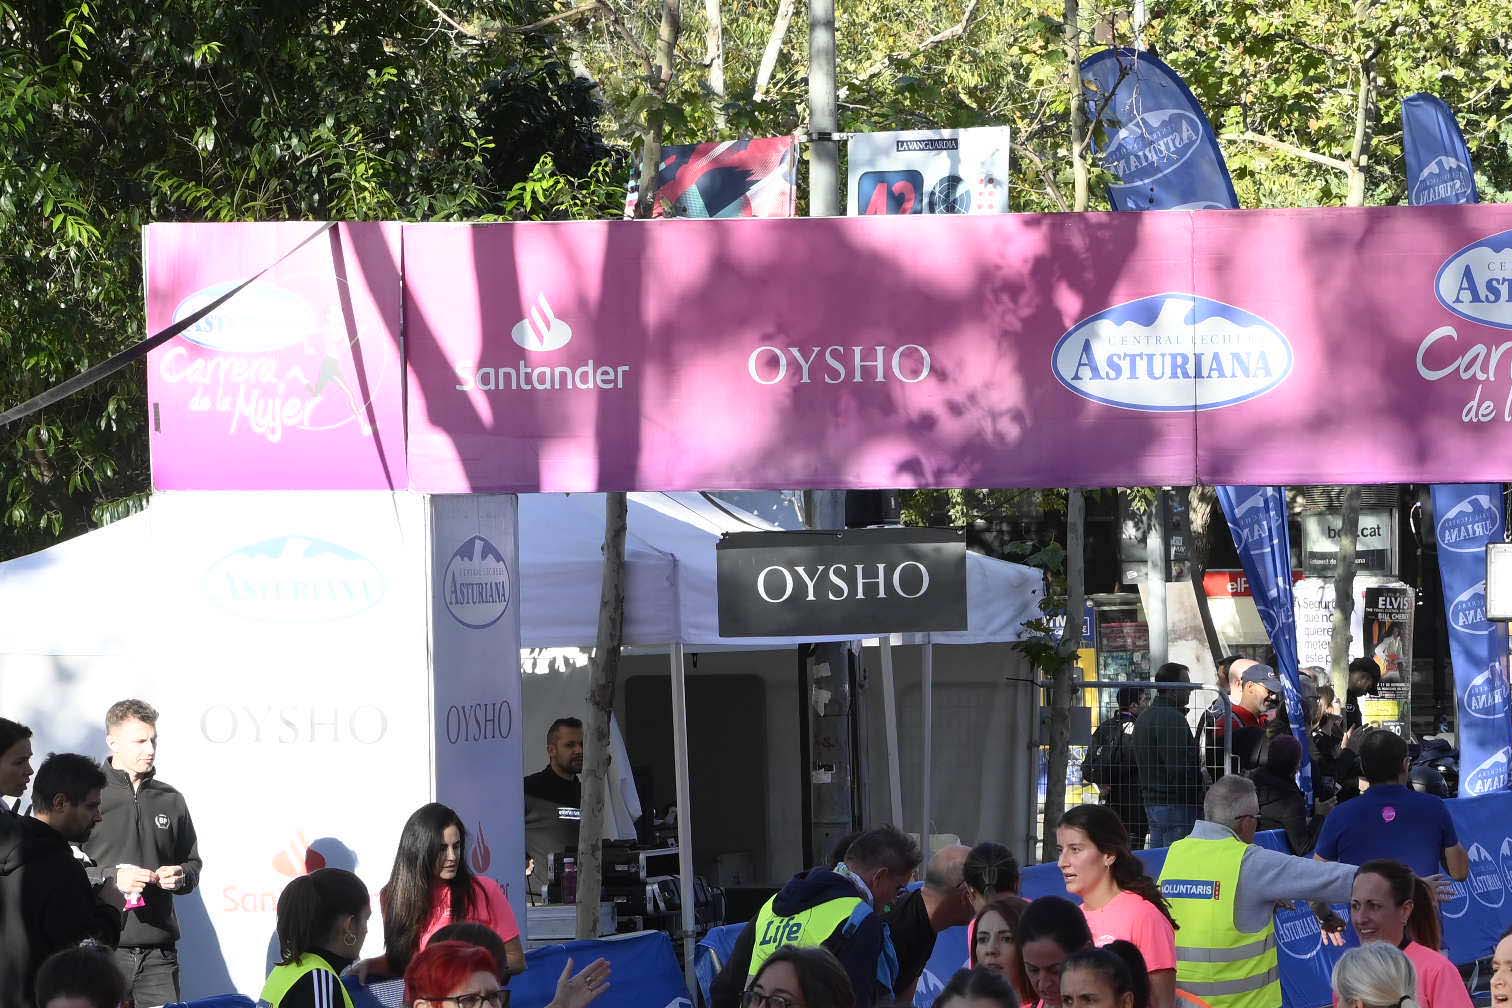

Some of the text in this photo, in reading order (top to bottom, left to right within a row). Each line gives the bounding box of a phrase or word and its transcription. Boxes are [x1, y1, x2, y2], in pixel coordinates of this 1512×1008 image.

[456, 360, 629, 393] Santander
[747, 344, 932, 385] OYSHO
[1071, 337, 1274, 381] ASTURIANA
[1461, 383, 1496, 424] de
[1328, 524, 1382, 539] bc.cat
[448, 571, 507, 606] ASTURIANA
[757, 560, 931, 604] OYSHO
[1378, 596, 1410, 610] ELVIS
[1304, 626, 1333, 640] quiere
[199, 703, 389, 745] OYSHO
[446, 700, 513, 745] OYSHO
[759, 919, 802, 947] Life
